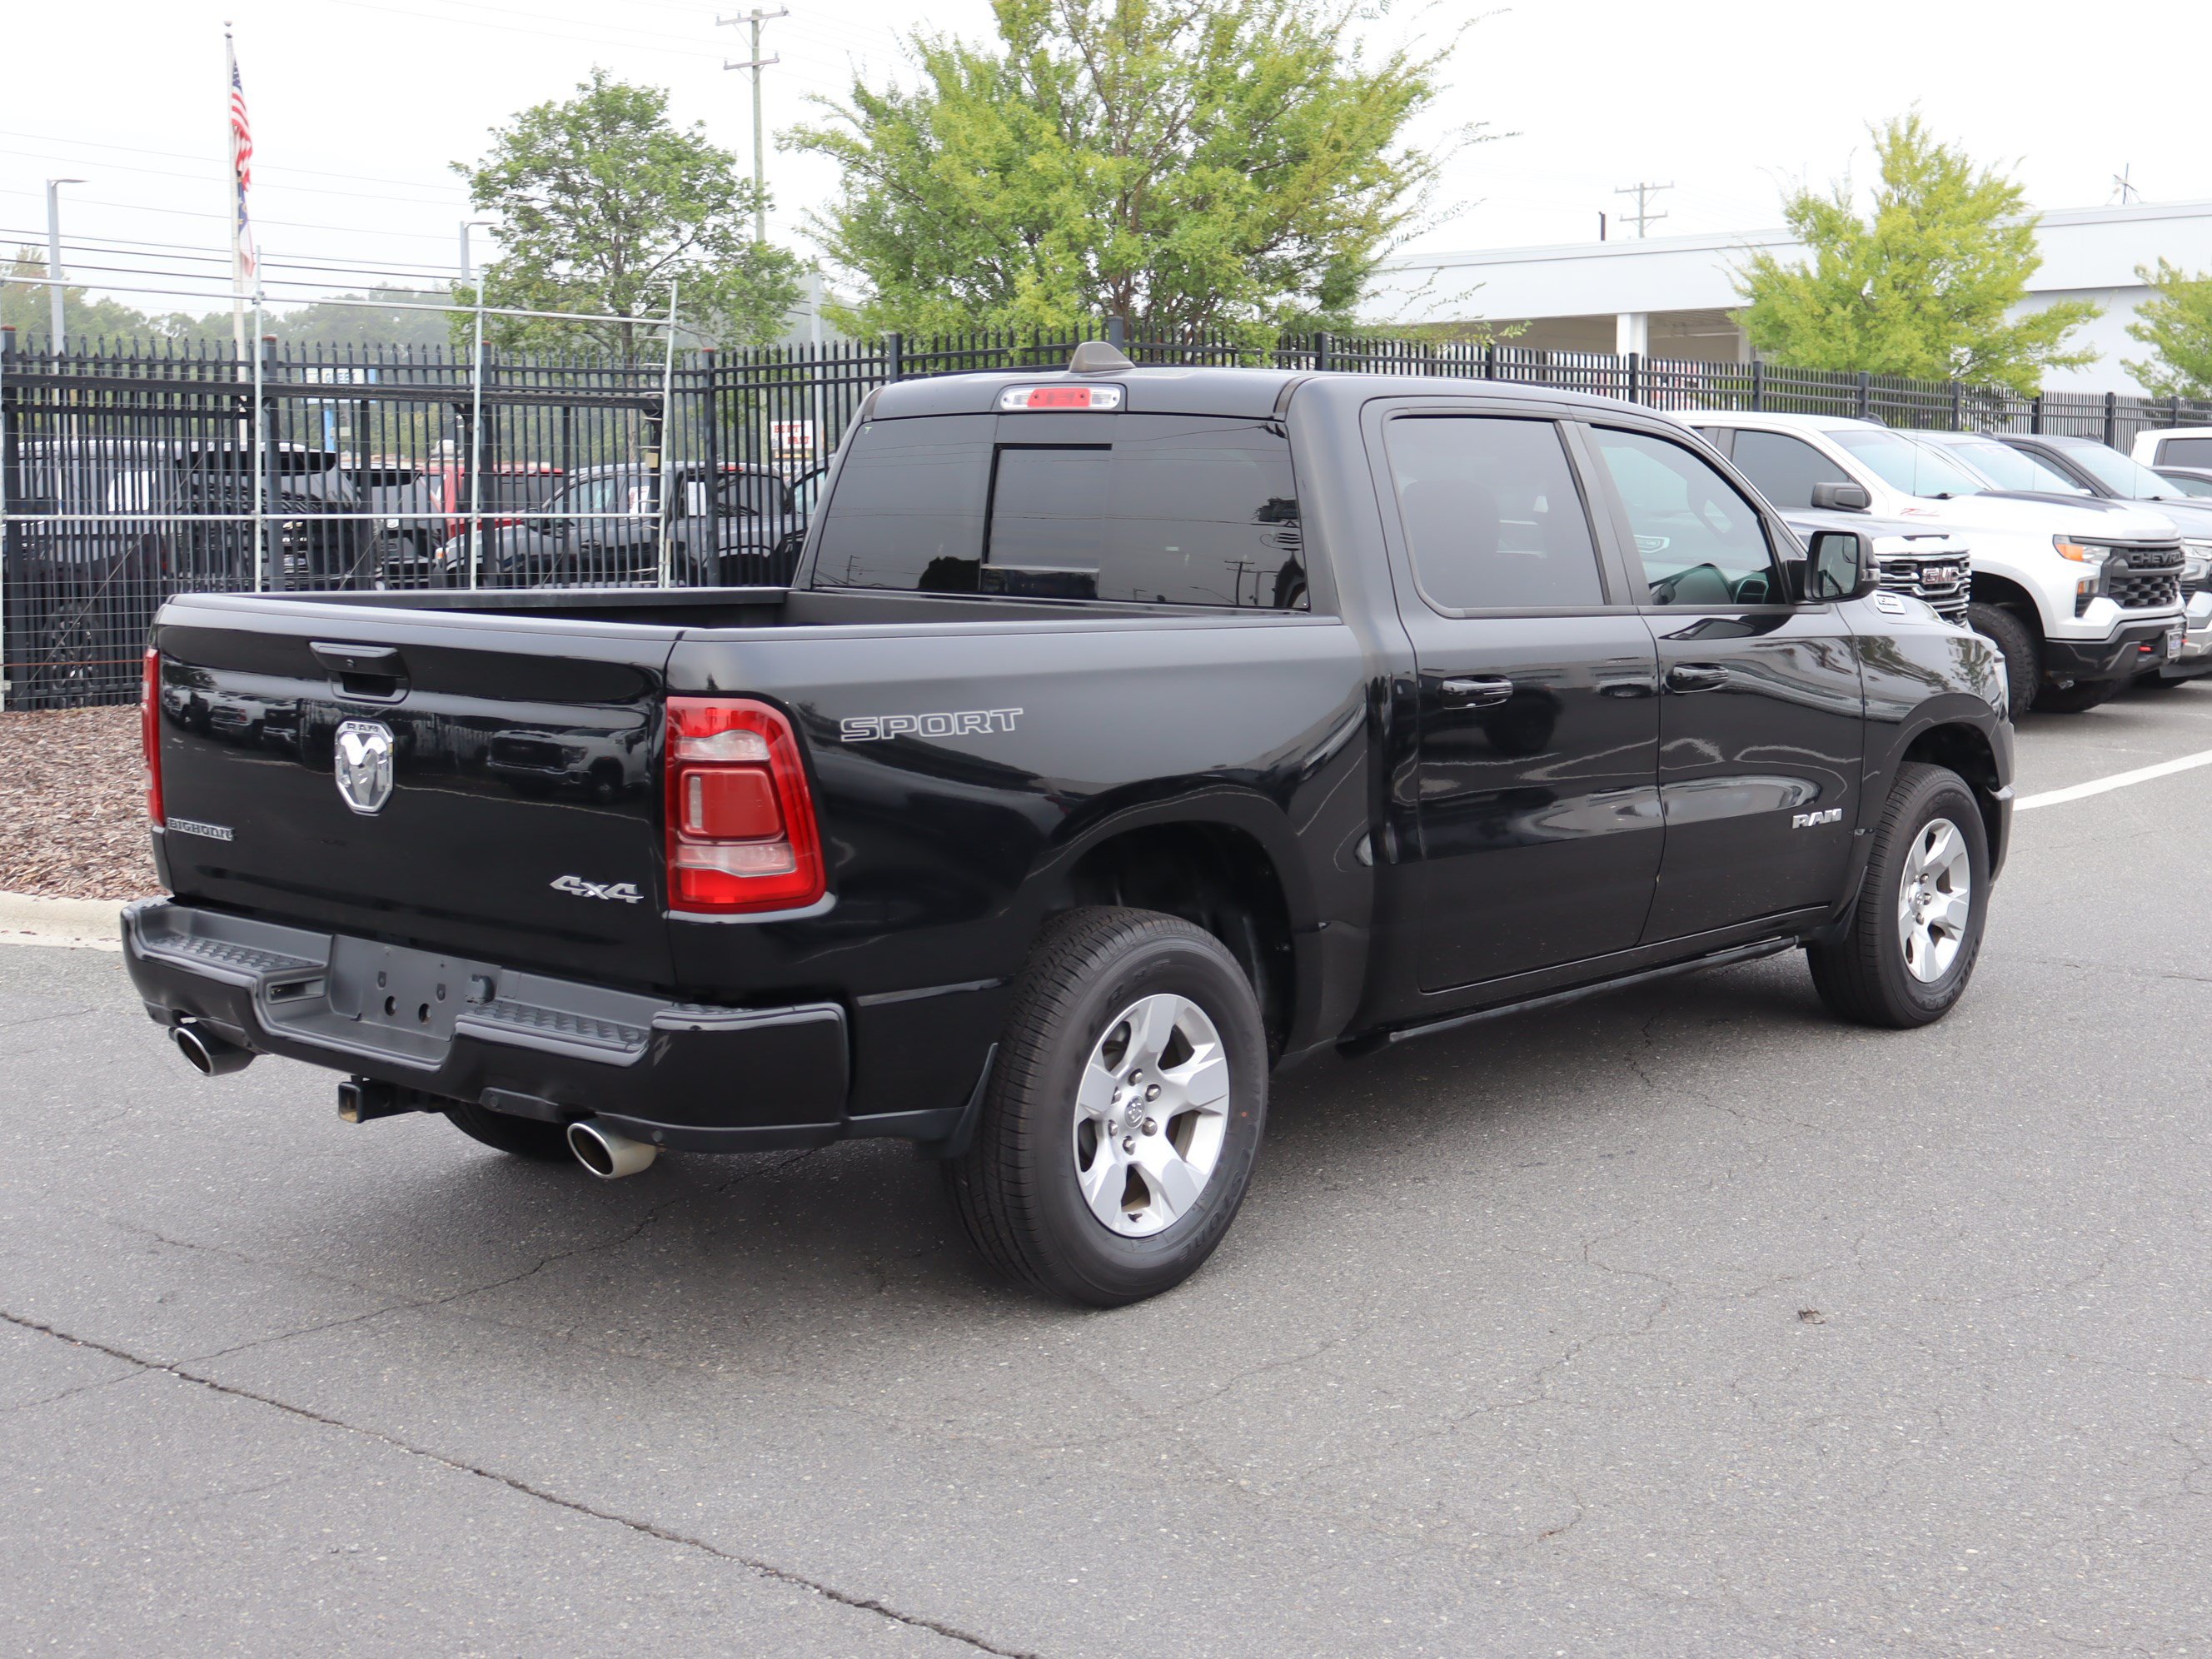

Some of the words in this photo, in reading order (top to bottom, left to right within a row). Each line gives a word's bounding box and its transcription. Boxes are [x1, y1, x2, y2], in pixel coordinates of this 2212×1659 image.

[1922, 566, 1960, 585] GMC
[346, 722, 380, 733] RAM
[840, 708, 1024, 742] SPORT
[1791, 808, 1842, 830] RAM
